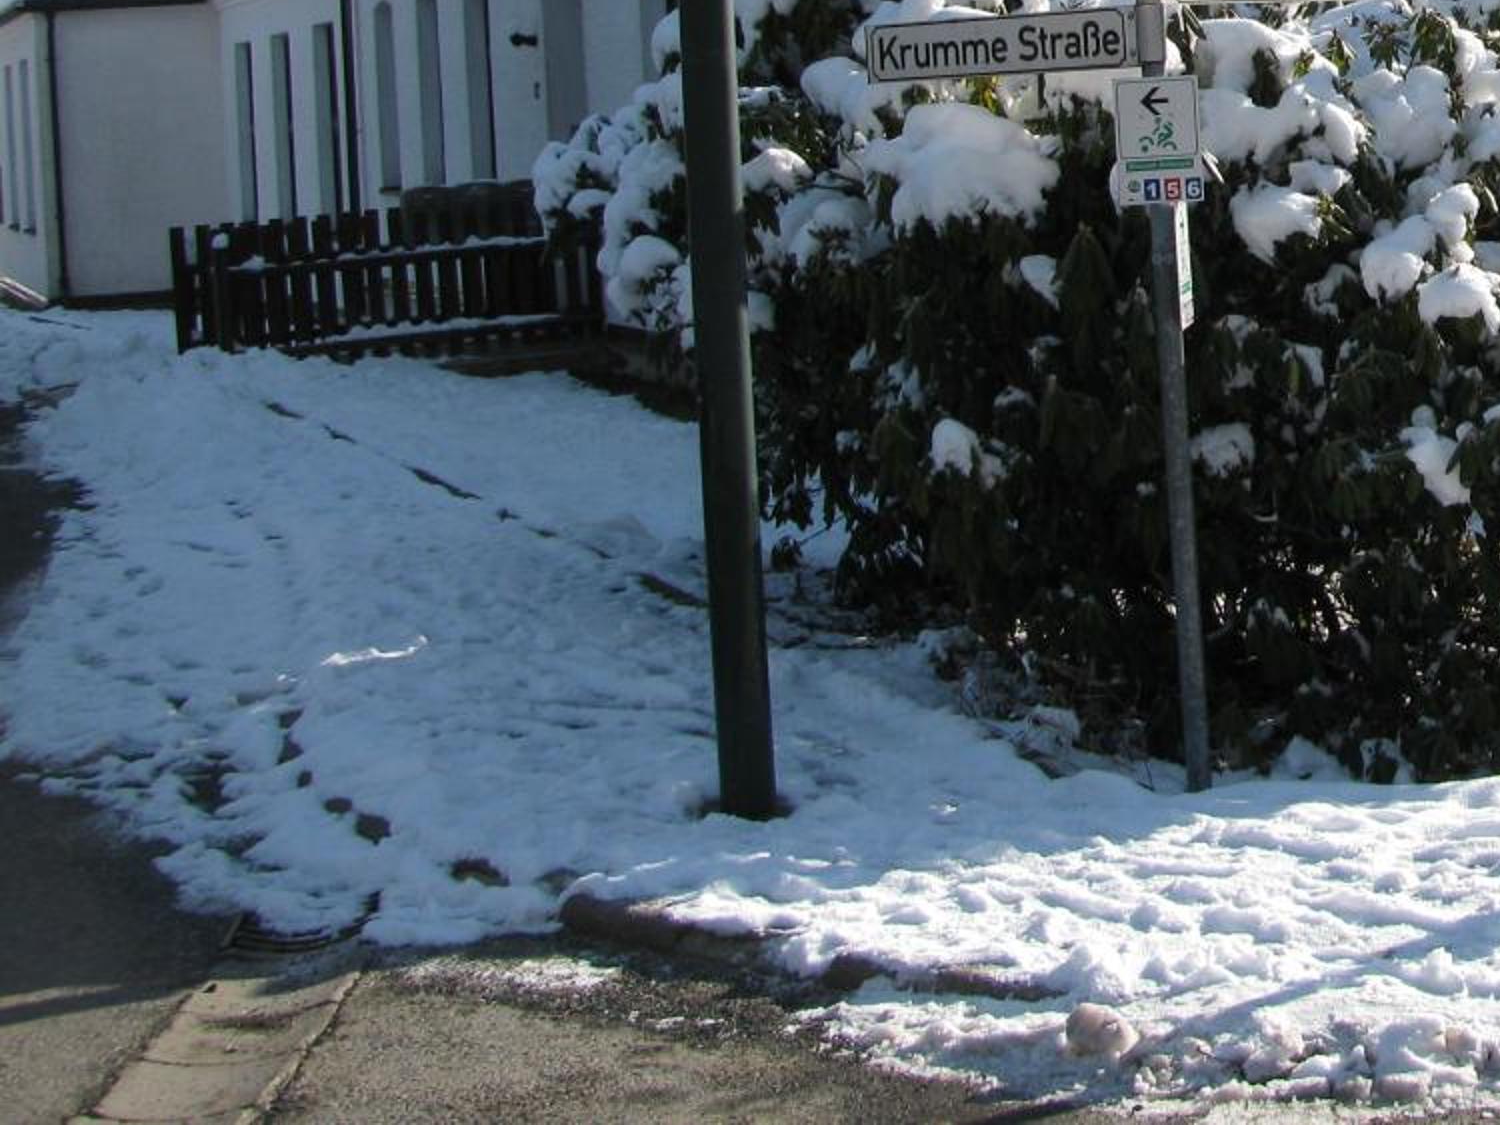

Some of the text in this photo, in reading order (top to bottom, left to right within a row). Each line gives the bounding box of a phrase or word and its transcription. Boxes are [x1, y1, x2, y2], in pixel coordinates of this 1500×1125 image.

[878, 20, 1121, 72] Krumme Straße
[1146, 179, 1201, 198] 1 5 6
